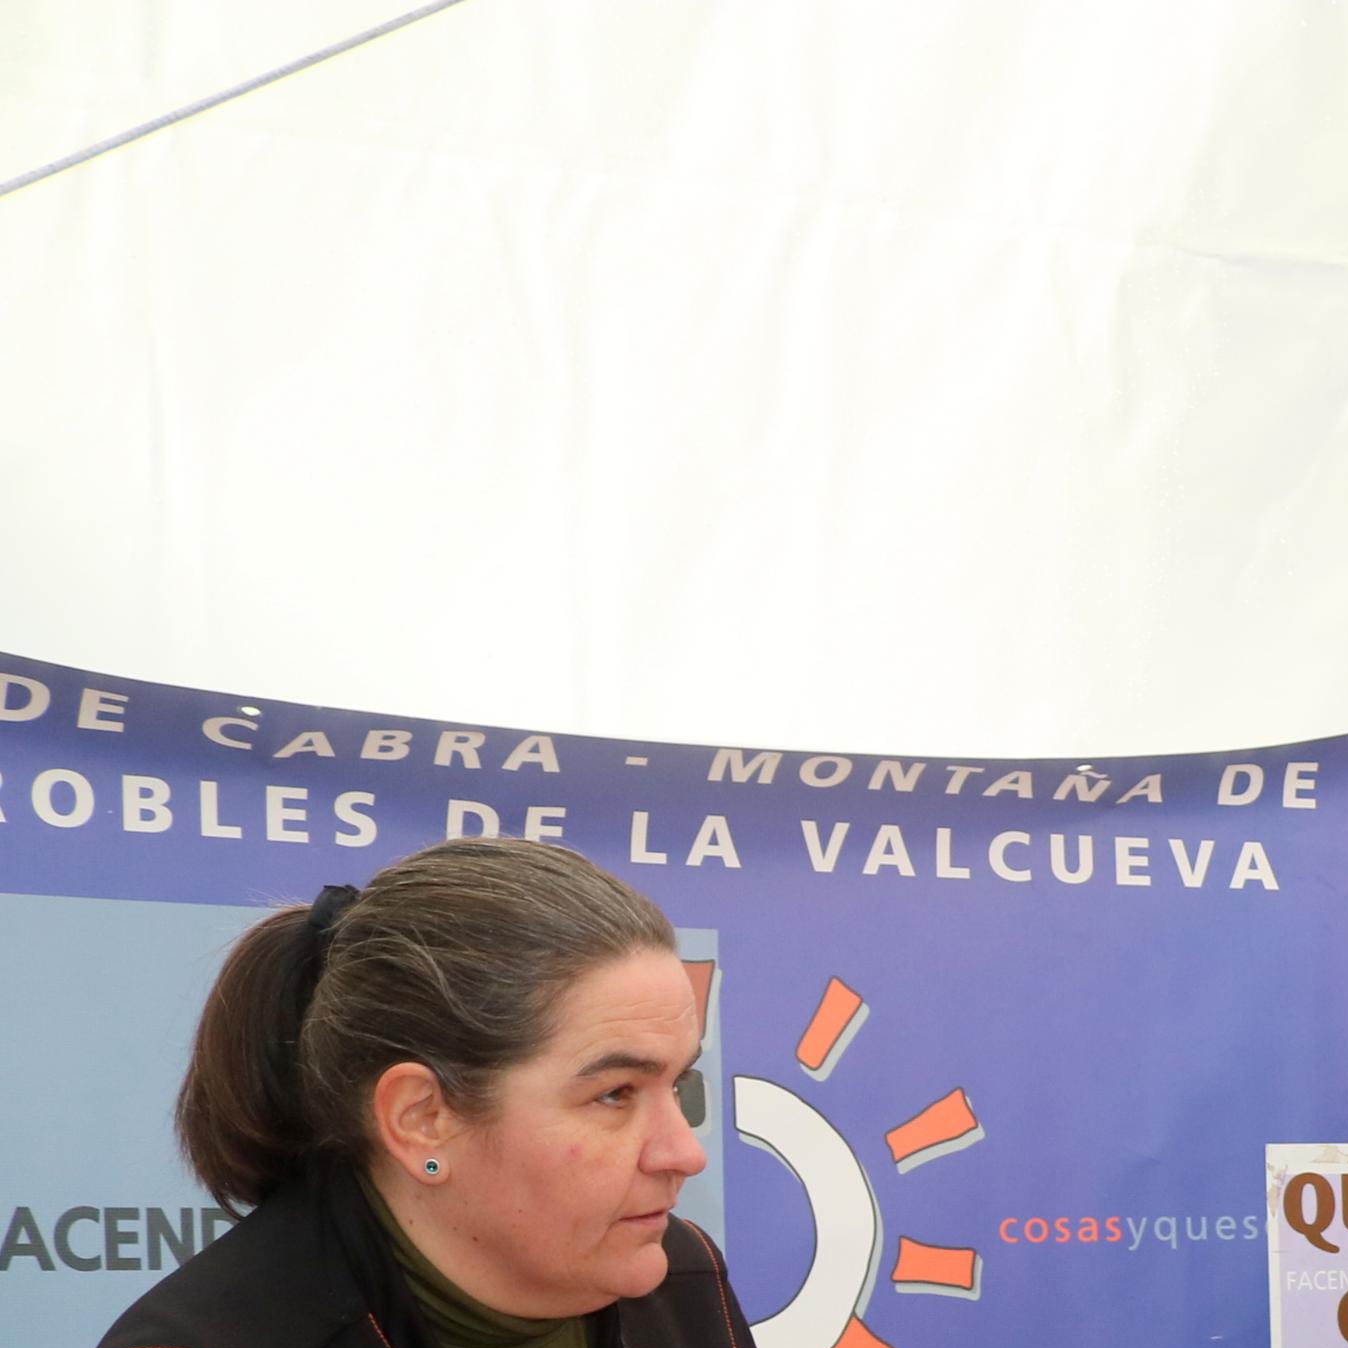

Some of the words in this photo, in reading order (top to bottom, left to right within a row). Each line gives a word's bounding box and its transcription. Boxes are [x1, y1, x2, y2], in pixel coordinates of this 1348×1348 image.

[0, 672, 130, 733] DE
[202, 716, 561, 773] CABRA
[707, 748, 1164, 804] MONTAÑA
[1217, 761, 1320, 809] DE
[0, 768, 378, 848] OBLES
[629, 811, 742, 869] LA
[800, 819, 1280, 891] VALCUEVA
[998, 1214, 1269, 1251] cosasyques
